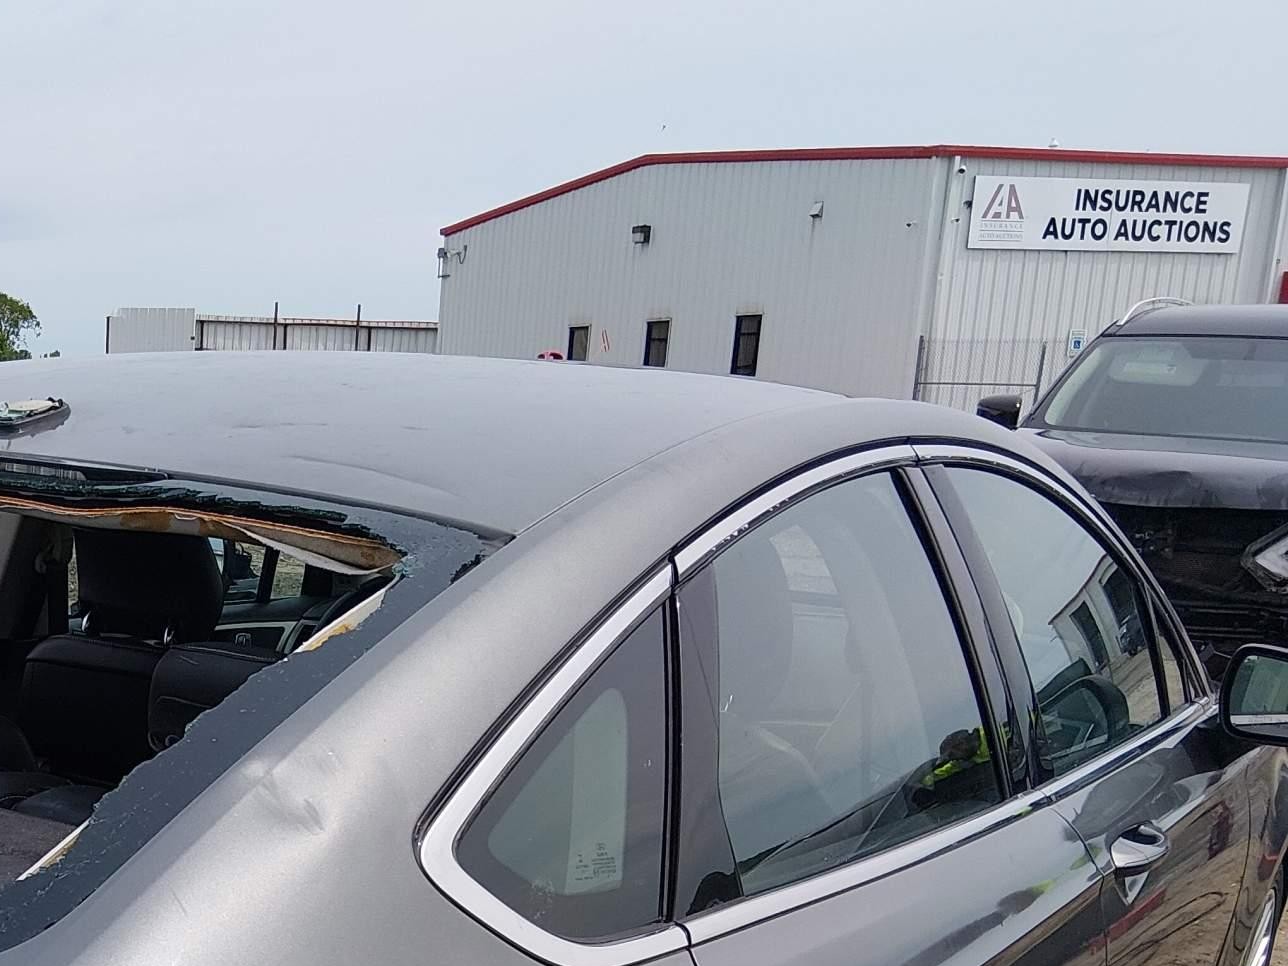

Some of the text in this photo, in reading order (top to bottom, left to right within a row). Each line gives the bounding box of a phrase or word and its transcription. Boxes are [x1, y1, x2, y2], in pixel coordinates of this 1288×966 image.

[1075, 188, 1210, 214] INSURANCE
[1042, 217, 1232, 244] AUTO AUCTIONS
